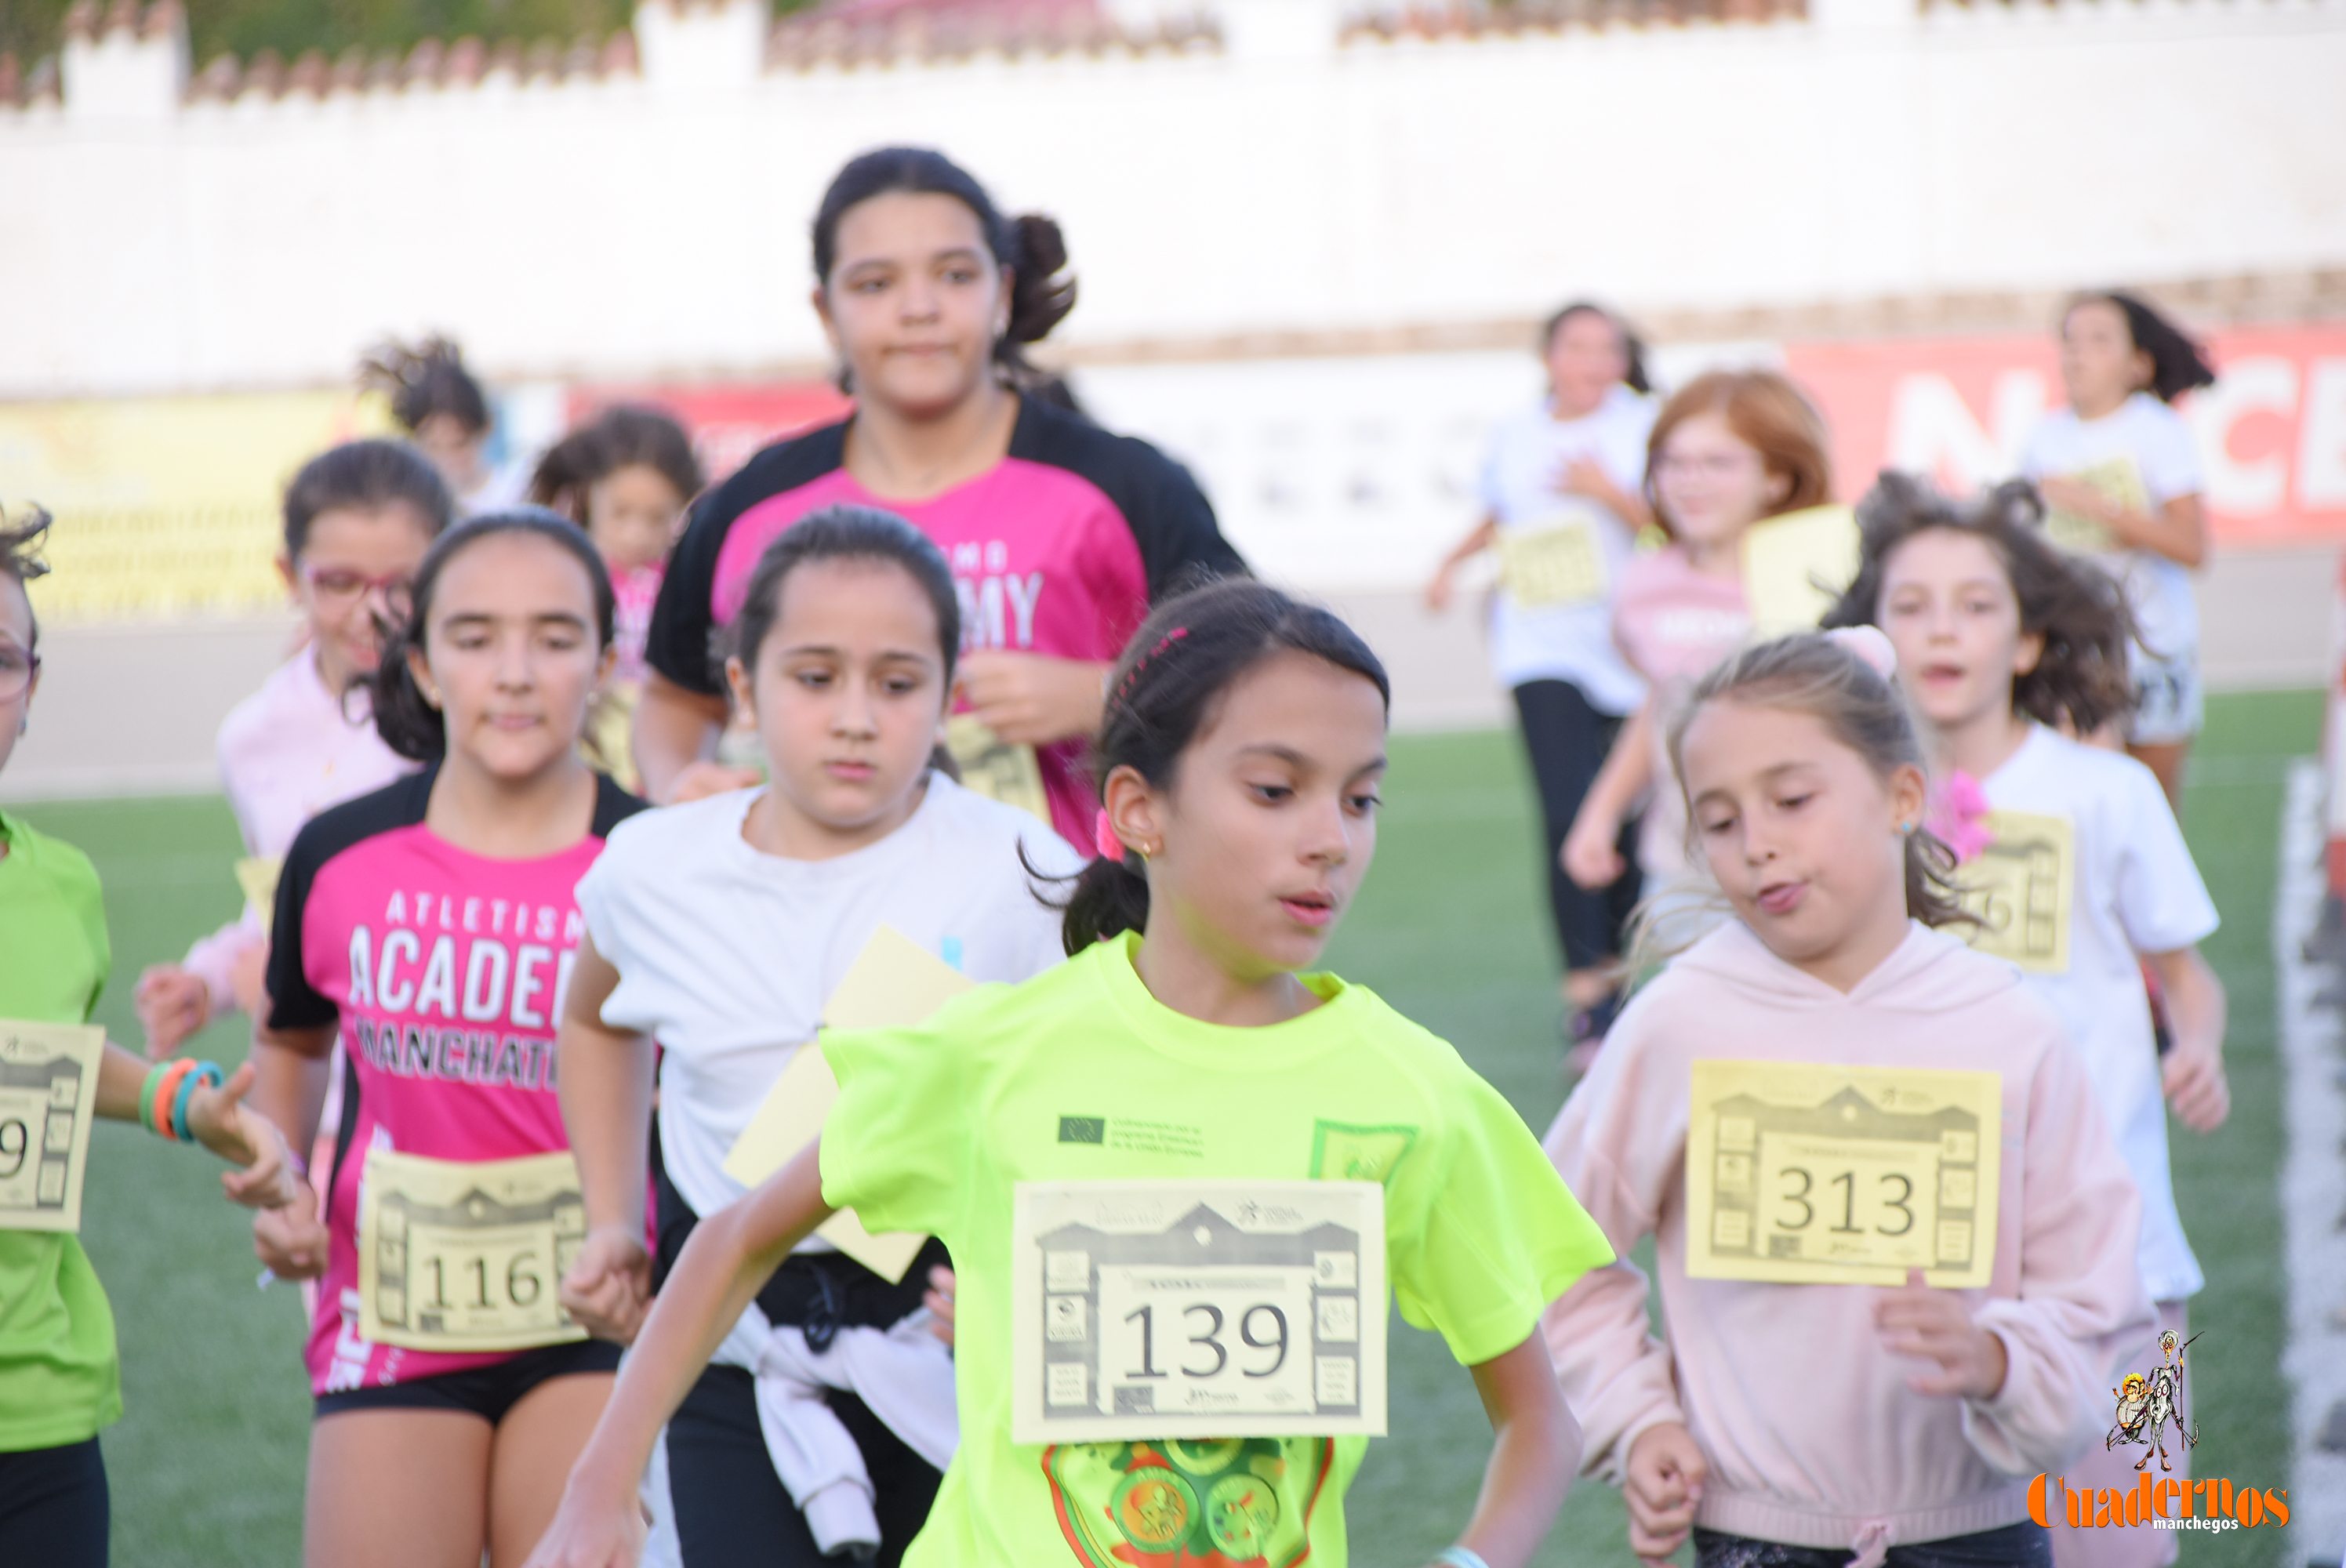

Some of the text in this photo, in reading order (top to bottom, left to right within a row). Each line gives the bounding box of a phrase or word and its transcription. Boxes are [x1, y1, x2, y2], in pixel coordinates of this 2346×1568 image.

[385, 889, 586, 942] ATLETISM
[348, 924, 576, 1033] ACADE
[1774, 1166, 1916, 1237] 313
[421, 1251, 541, 1310] 116
[1124, 1303, 1289, 1379] 139
